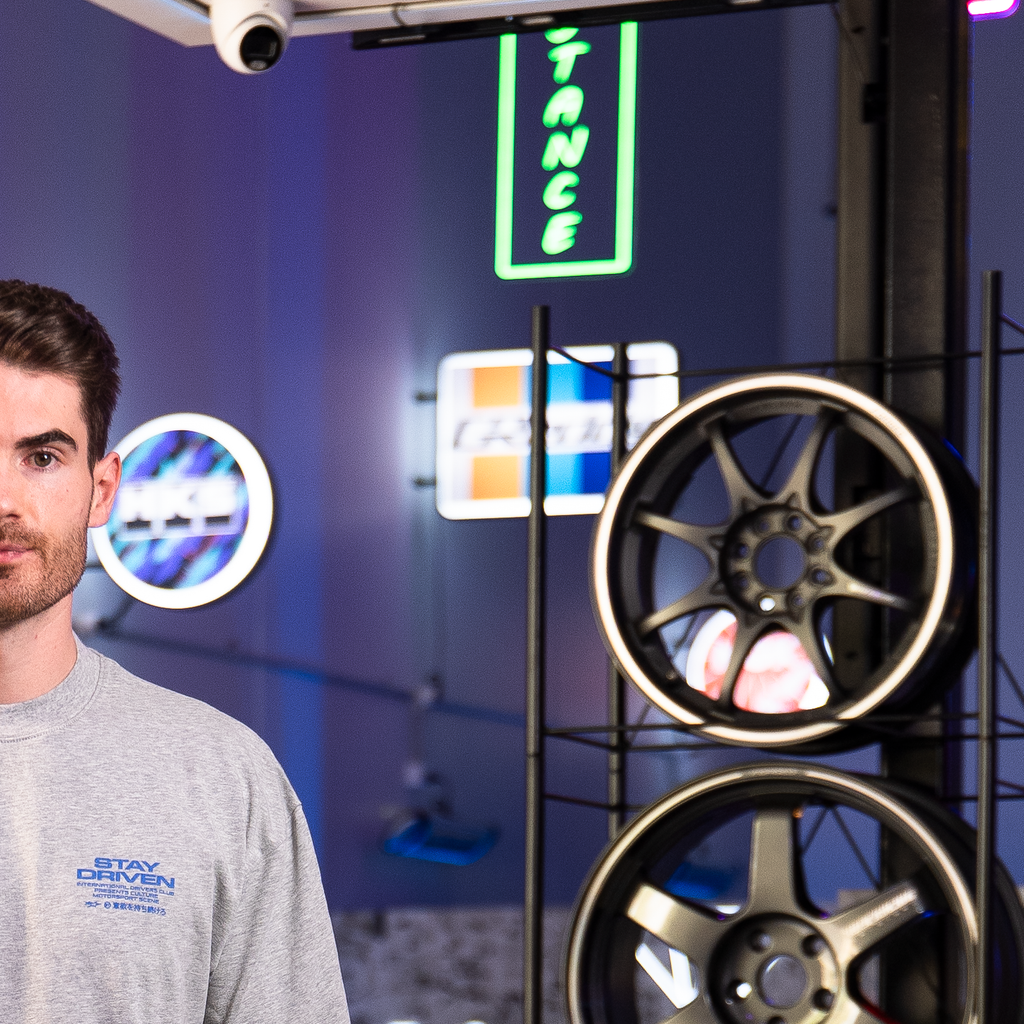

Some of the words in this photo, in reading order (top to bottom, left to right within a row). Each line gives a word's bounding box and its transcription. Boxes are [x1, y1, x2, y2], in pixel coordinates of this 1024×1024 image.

[94, 857, 160, 872] STAY
[77, 869, 175, 889] DRIVEN
[93, 893, 138, 902] MOTORSPORT
[130, 891, 159, 899] CULTURE
